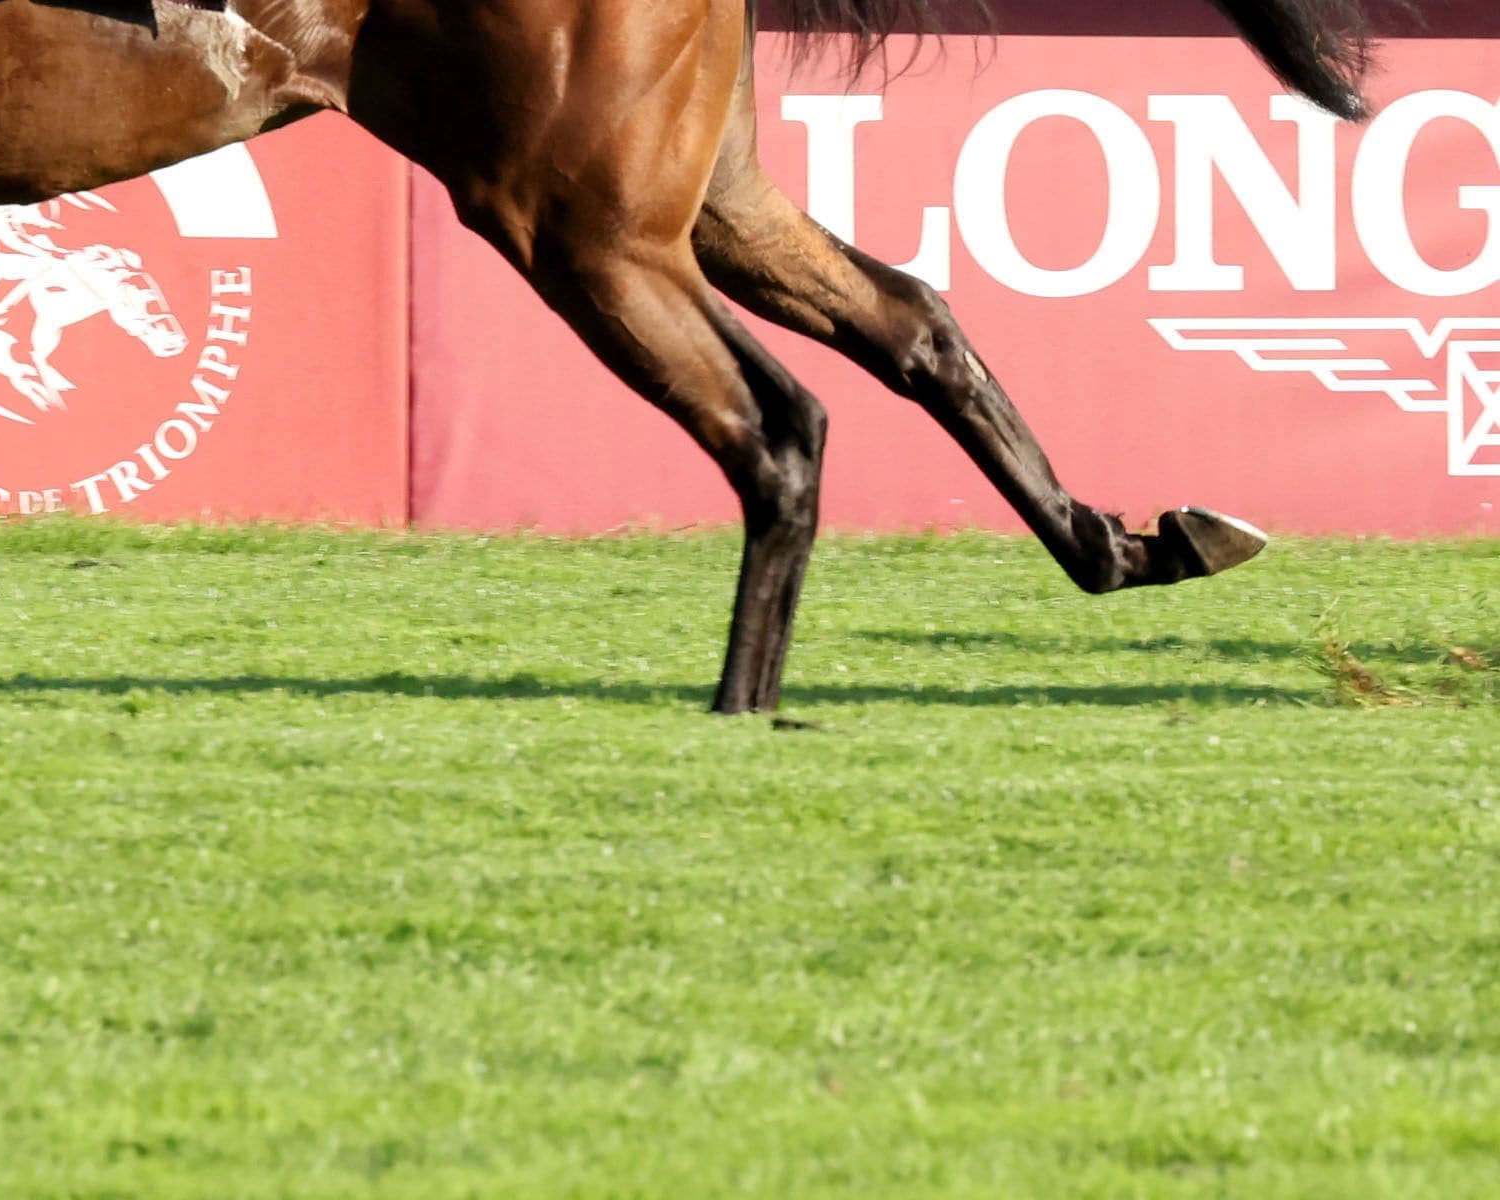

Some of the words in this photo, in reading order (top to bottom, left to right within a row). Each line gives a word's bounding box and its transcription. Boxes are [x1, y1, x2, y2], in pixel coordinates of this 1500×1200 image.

[781, 89, 1500, 297] LONG
[17, 489, 66, 515] DE
[69, 266, 252, 515] TRIOMPHE
